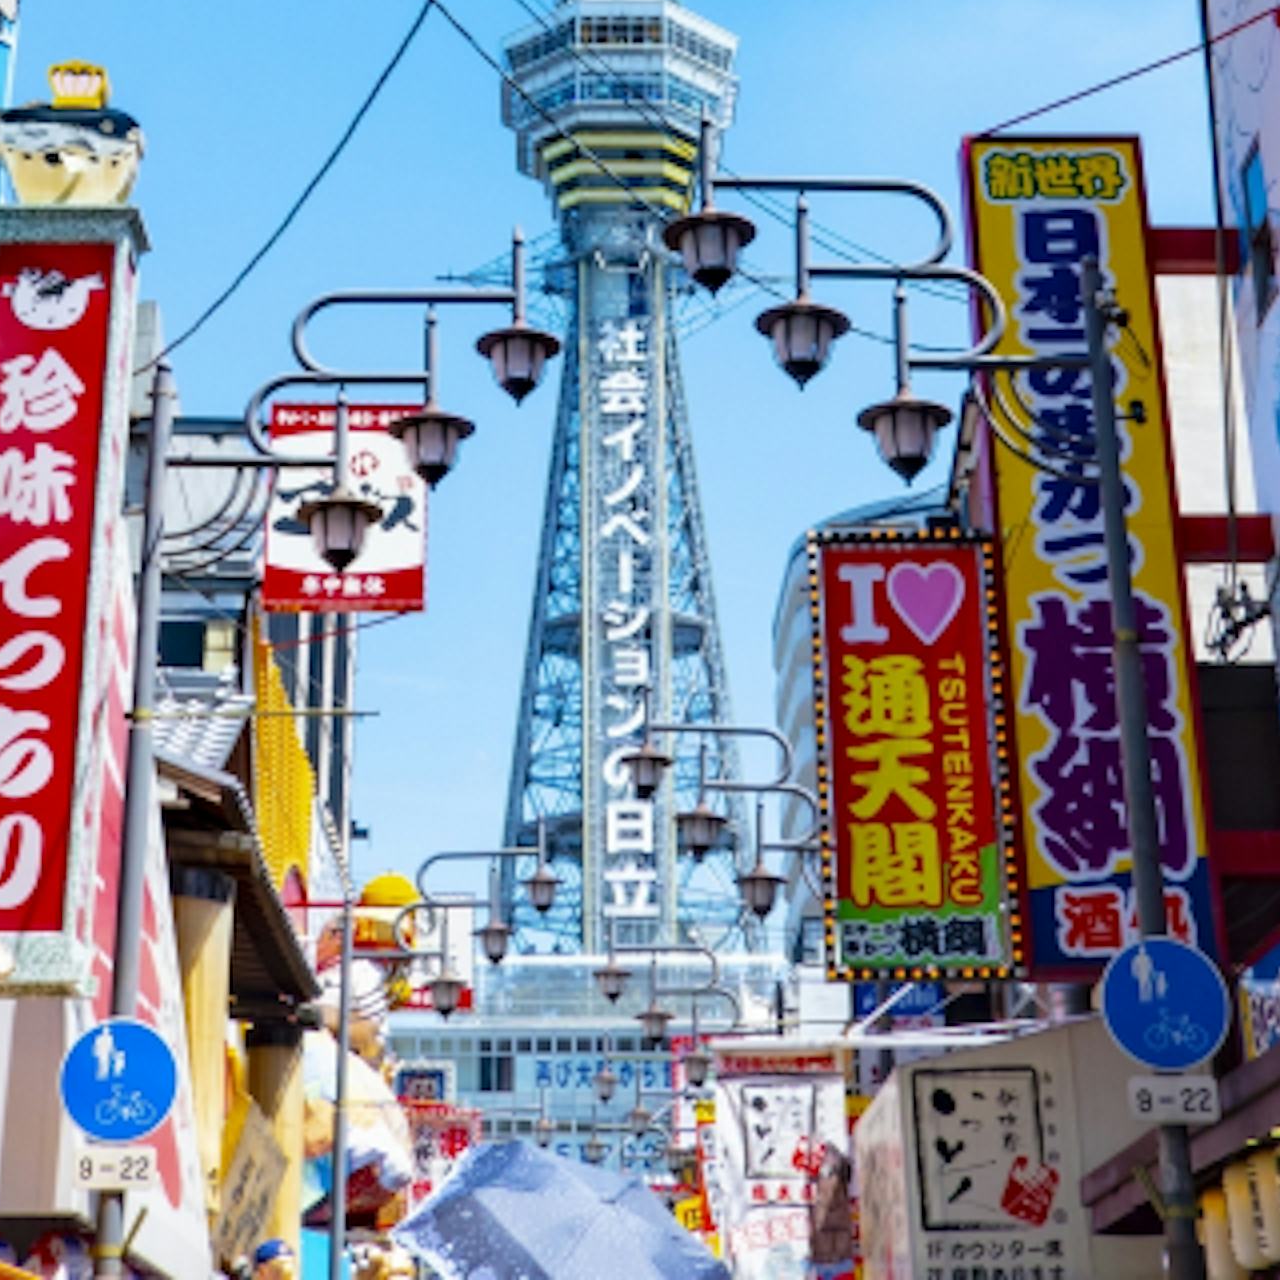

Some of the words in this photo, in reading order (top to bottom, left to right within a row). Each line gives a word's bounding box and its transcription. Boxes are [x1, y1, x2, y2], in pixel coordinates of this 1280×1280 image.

[986, 152, 1125, 198] 新世界
[838, 563, 889, 644] I
[841, 654, 941, 908] 通天閣
[939, 652, 982, 904] TSUTENKAKU
